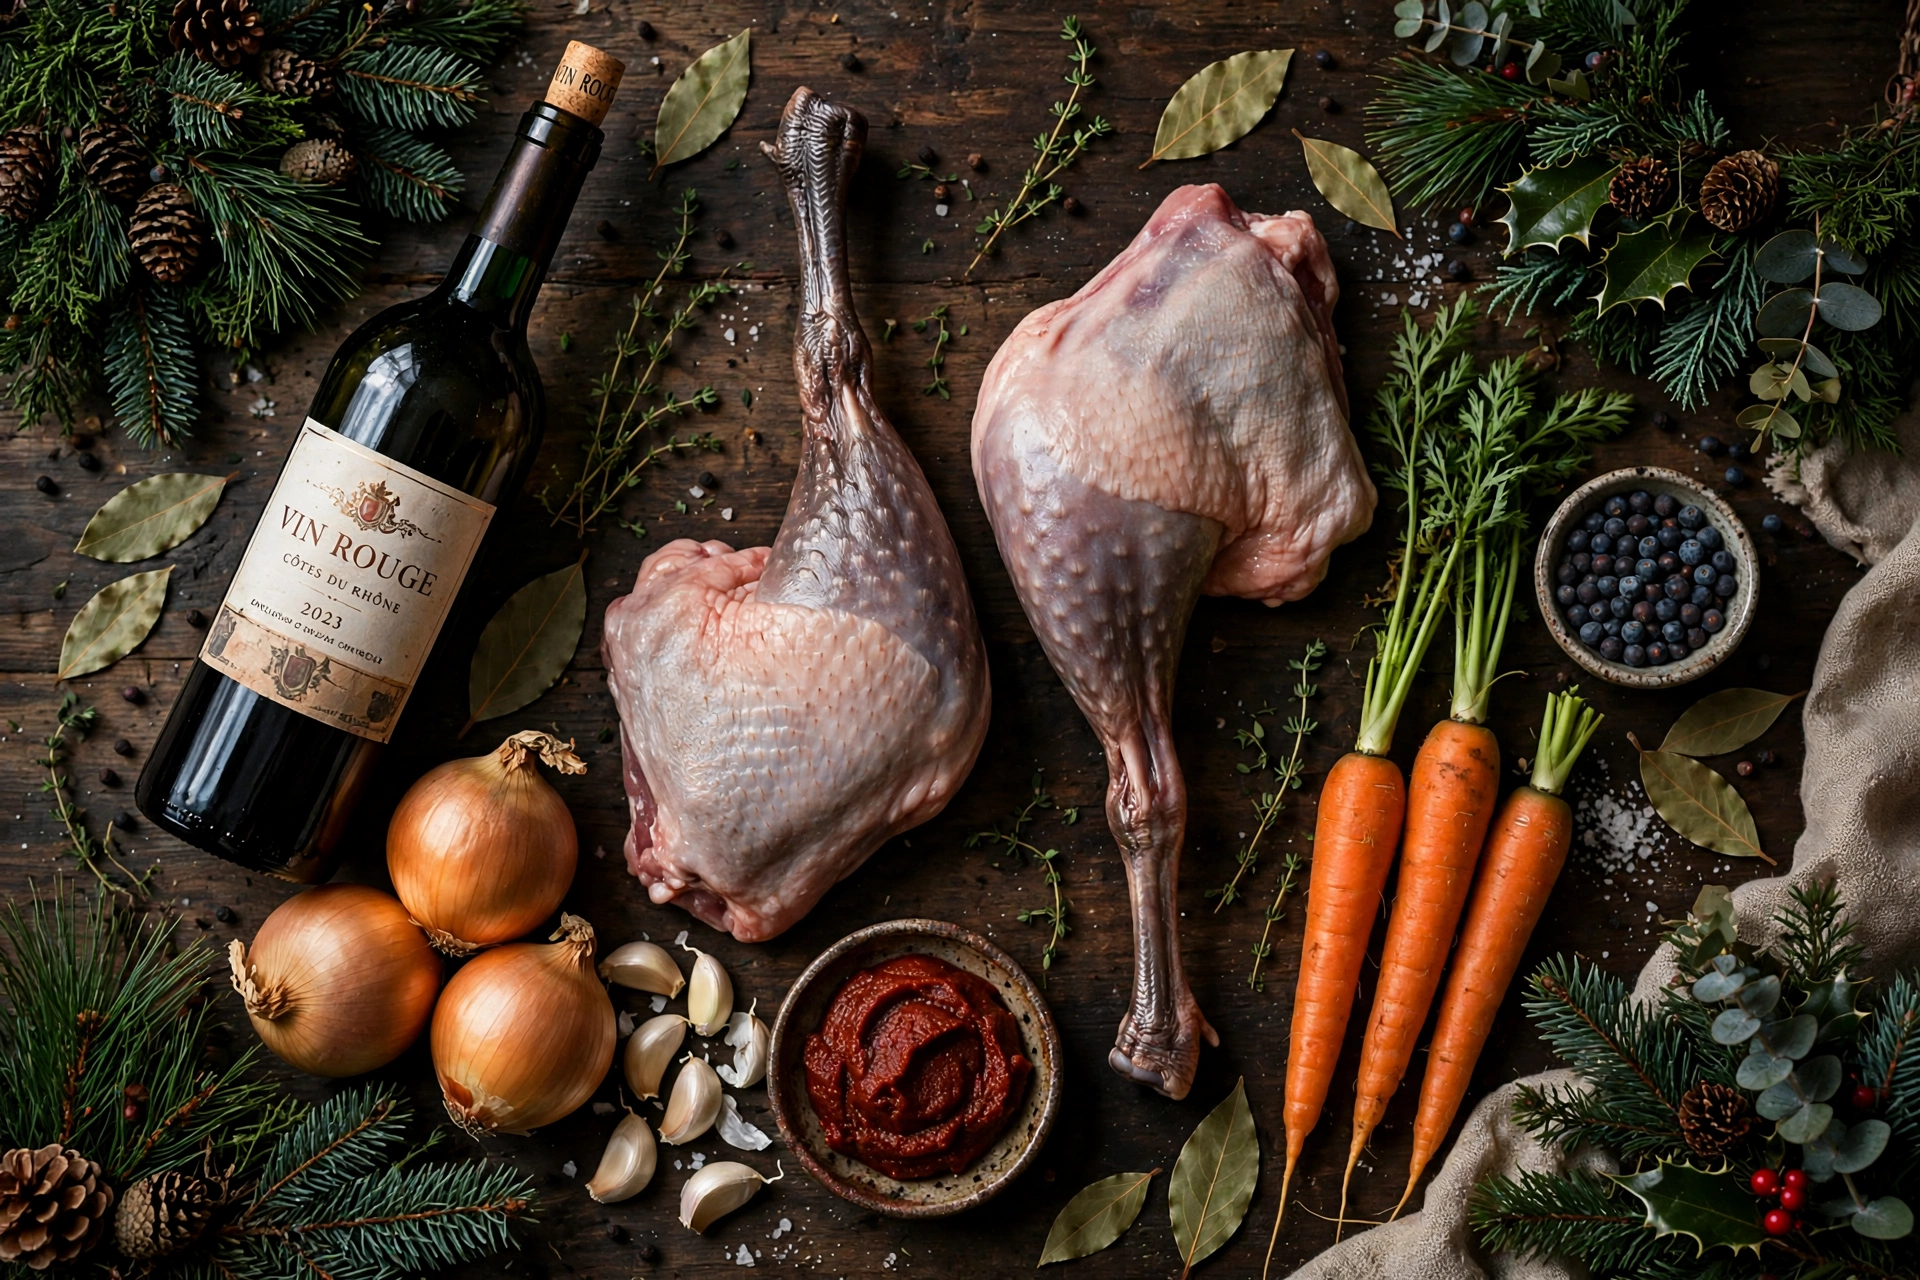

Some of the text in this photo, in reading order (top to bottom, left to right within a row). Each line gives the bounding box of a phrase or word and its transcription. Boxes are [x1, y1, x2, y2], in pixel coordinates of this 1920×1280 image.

[555, 65, 577, 86] VIN
[280, 504, 438, 597] VIN ROUGE
[283, 552, 401, 615] CÔTES DU RHÔNE
[300, 601, 343, 630] 2023
